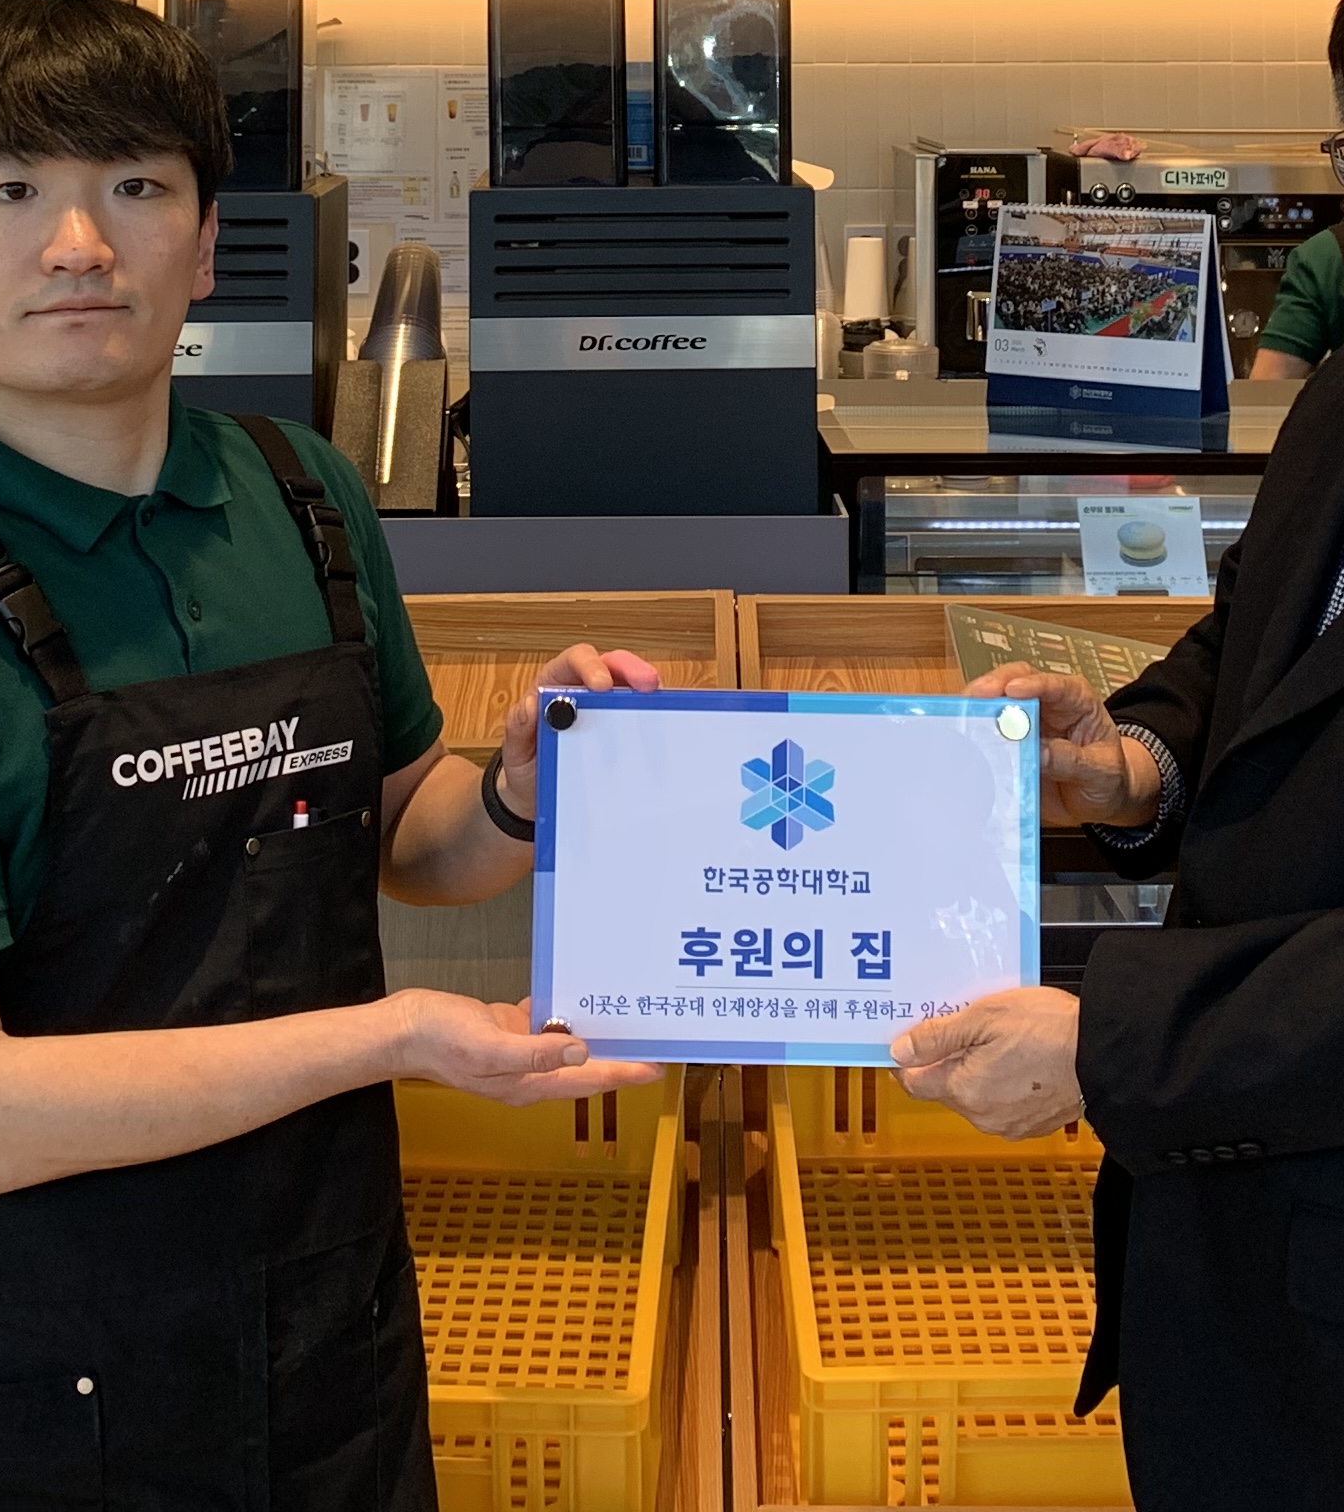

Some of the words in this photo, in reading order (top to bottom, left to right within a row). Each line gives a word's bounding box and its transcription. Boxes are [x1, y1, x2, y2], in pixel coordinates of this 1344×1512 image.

[970, 166, 997, 174] HANA
[1165, 171, 1226, 187] 디카페인
[579, 334, 707, 352] Dr.coffee
[111, 717, 300, 787] COFFEEBAY
[288, 744, 348, 771] EXPRESS
[703, 865, 872, 896] 한국공학대학교
[678, 926, 825, 980] 후원의
[850, 930, 893, 980] 집
[579, 995, 631, 1016] 이곳은
[637, 996, 705, 1017] 한국공대
[712, 997, 798, 1019] 인재양성을
[804, 999, 838, 1019] 위해
[843, 999, 914, 1020] 후원하고
[920, 1001, 971, 1021] 있습
